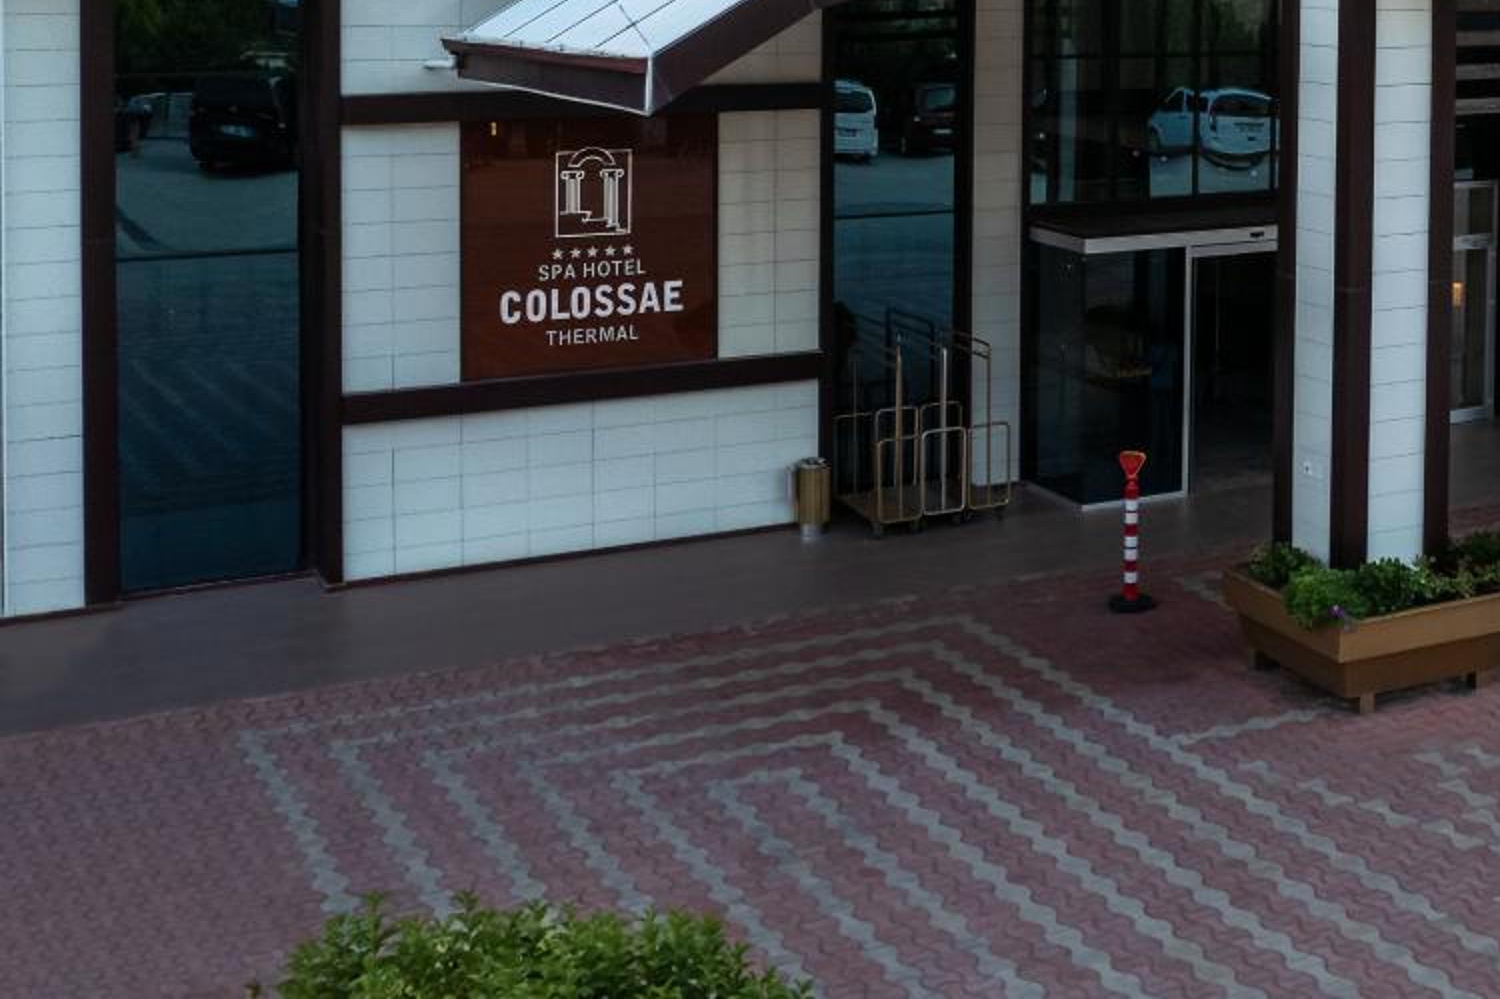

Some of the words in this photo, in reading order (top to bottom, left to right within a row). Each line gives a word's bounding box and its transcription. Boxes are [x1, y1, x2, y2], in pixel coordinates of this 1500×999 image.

[538, 264, 577, 281] SPA
[582, 258, 647, 279] HOTEL
[500, 280, 685, 324] COLOSSAE
[545, 324, 640, 346] THERMAL
